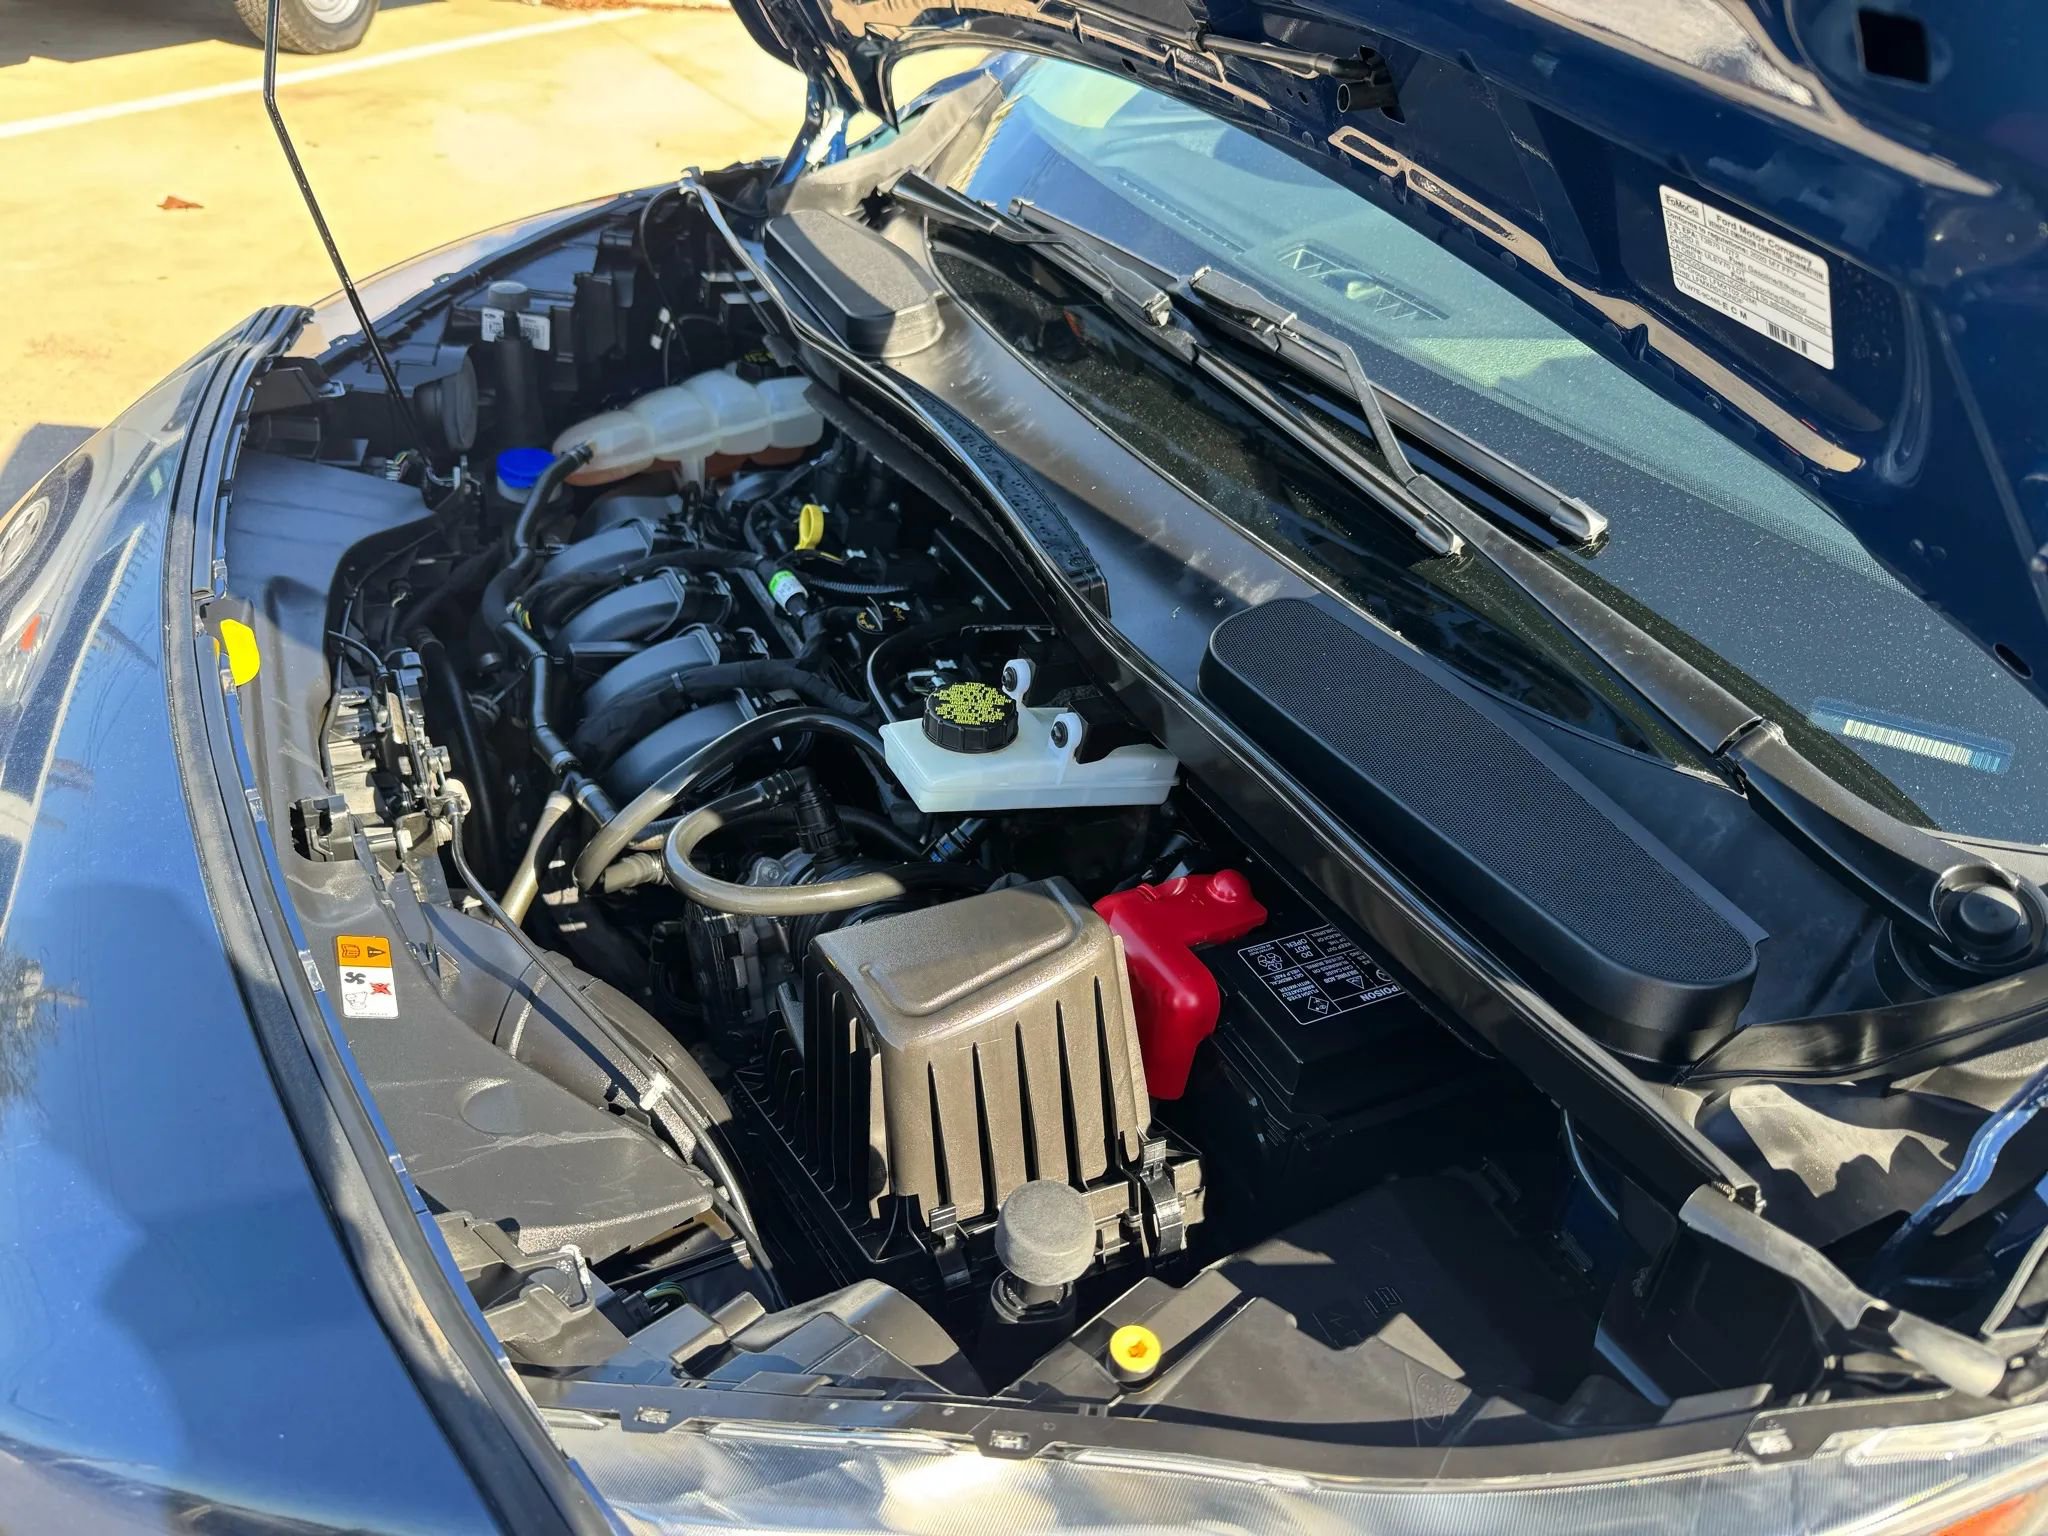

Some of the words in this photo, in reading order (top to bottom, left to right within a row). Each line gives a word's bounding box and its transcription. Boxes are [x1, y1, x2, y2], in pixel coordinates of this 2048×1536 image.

[1716, 213, 1736, 230] Ford
[1739, 224, 1765, 244] Motor
[1767, 237, 1812, 269] Company
[1291, 944, 1311, 953] NOT
[1298, 950, 1314, 958] DO
